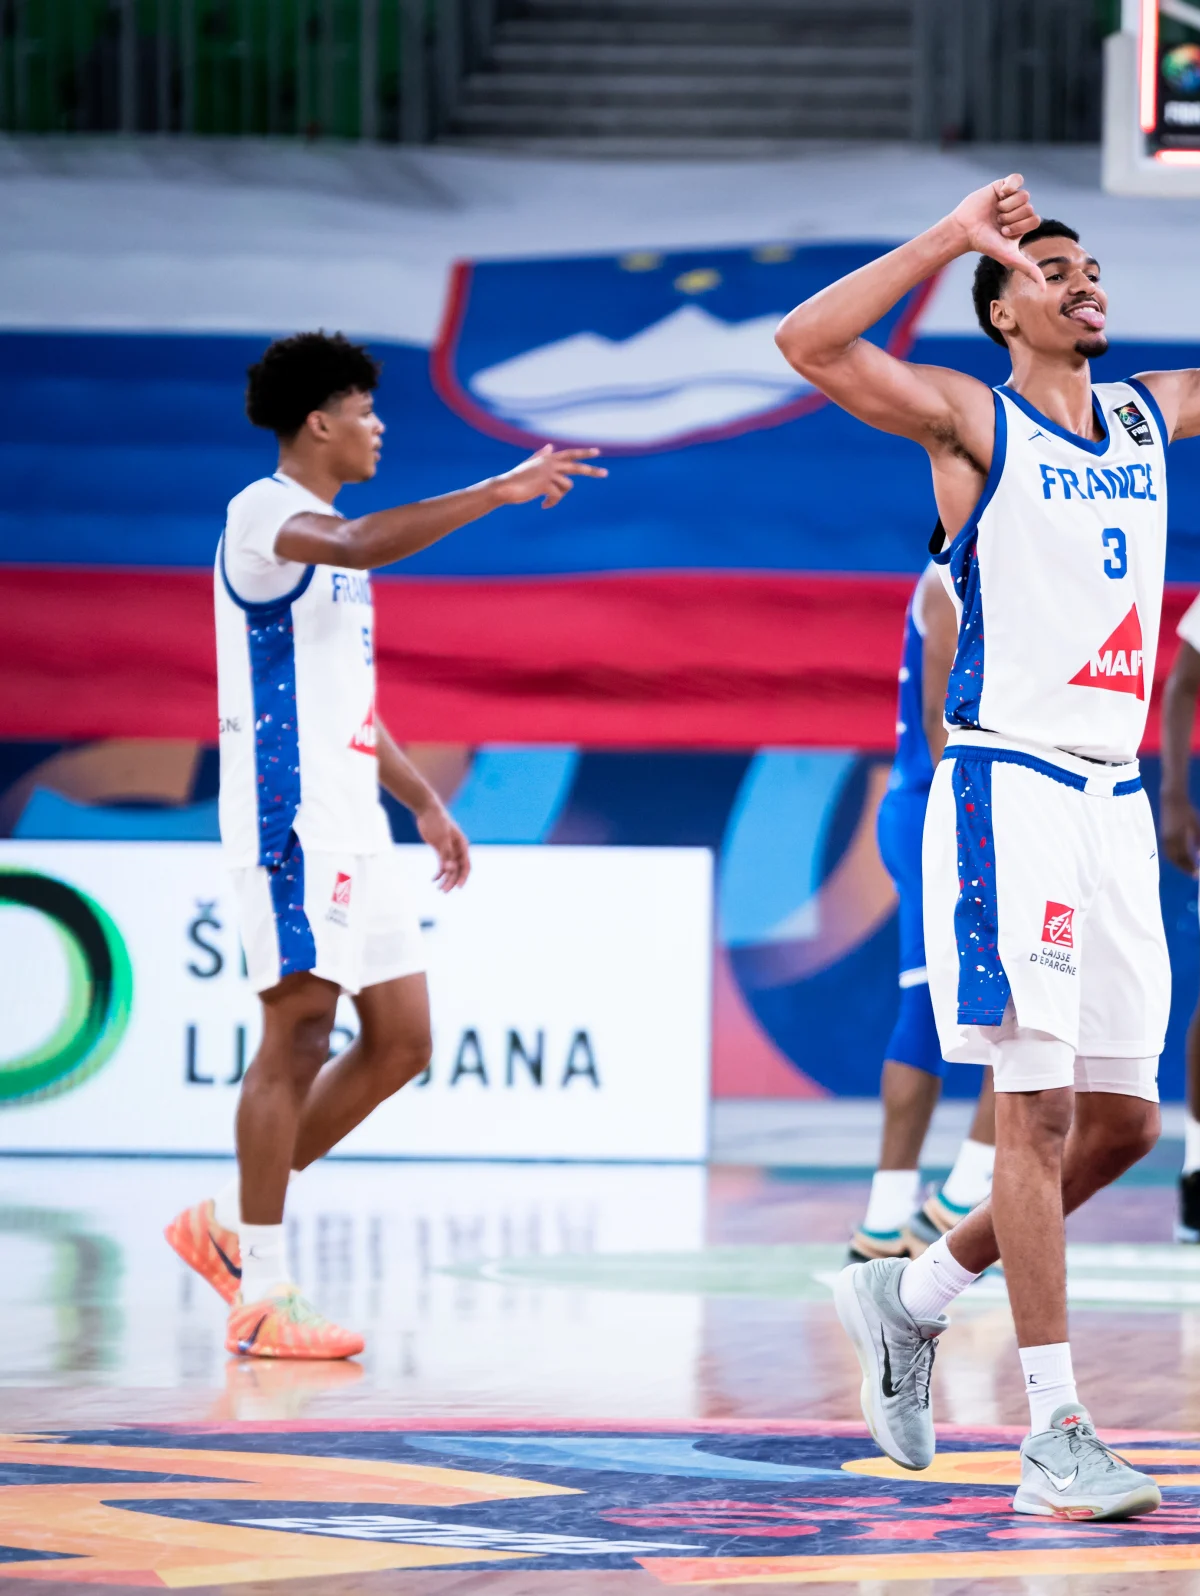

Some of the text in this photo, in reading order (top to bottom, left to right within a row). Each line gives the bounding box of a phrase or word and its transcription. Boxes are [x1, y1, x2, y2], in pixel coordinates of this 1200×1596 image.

[1131, 424, 1149, 437] FIBA
[1039, 463, 1157, 501] FRANCE
[1101, 527, 1127, 579] 3
[1042, 947, 1071, 963] CAISSE
